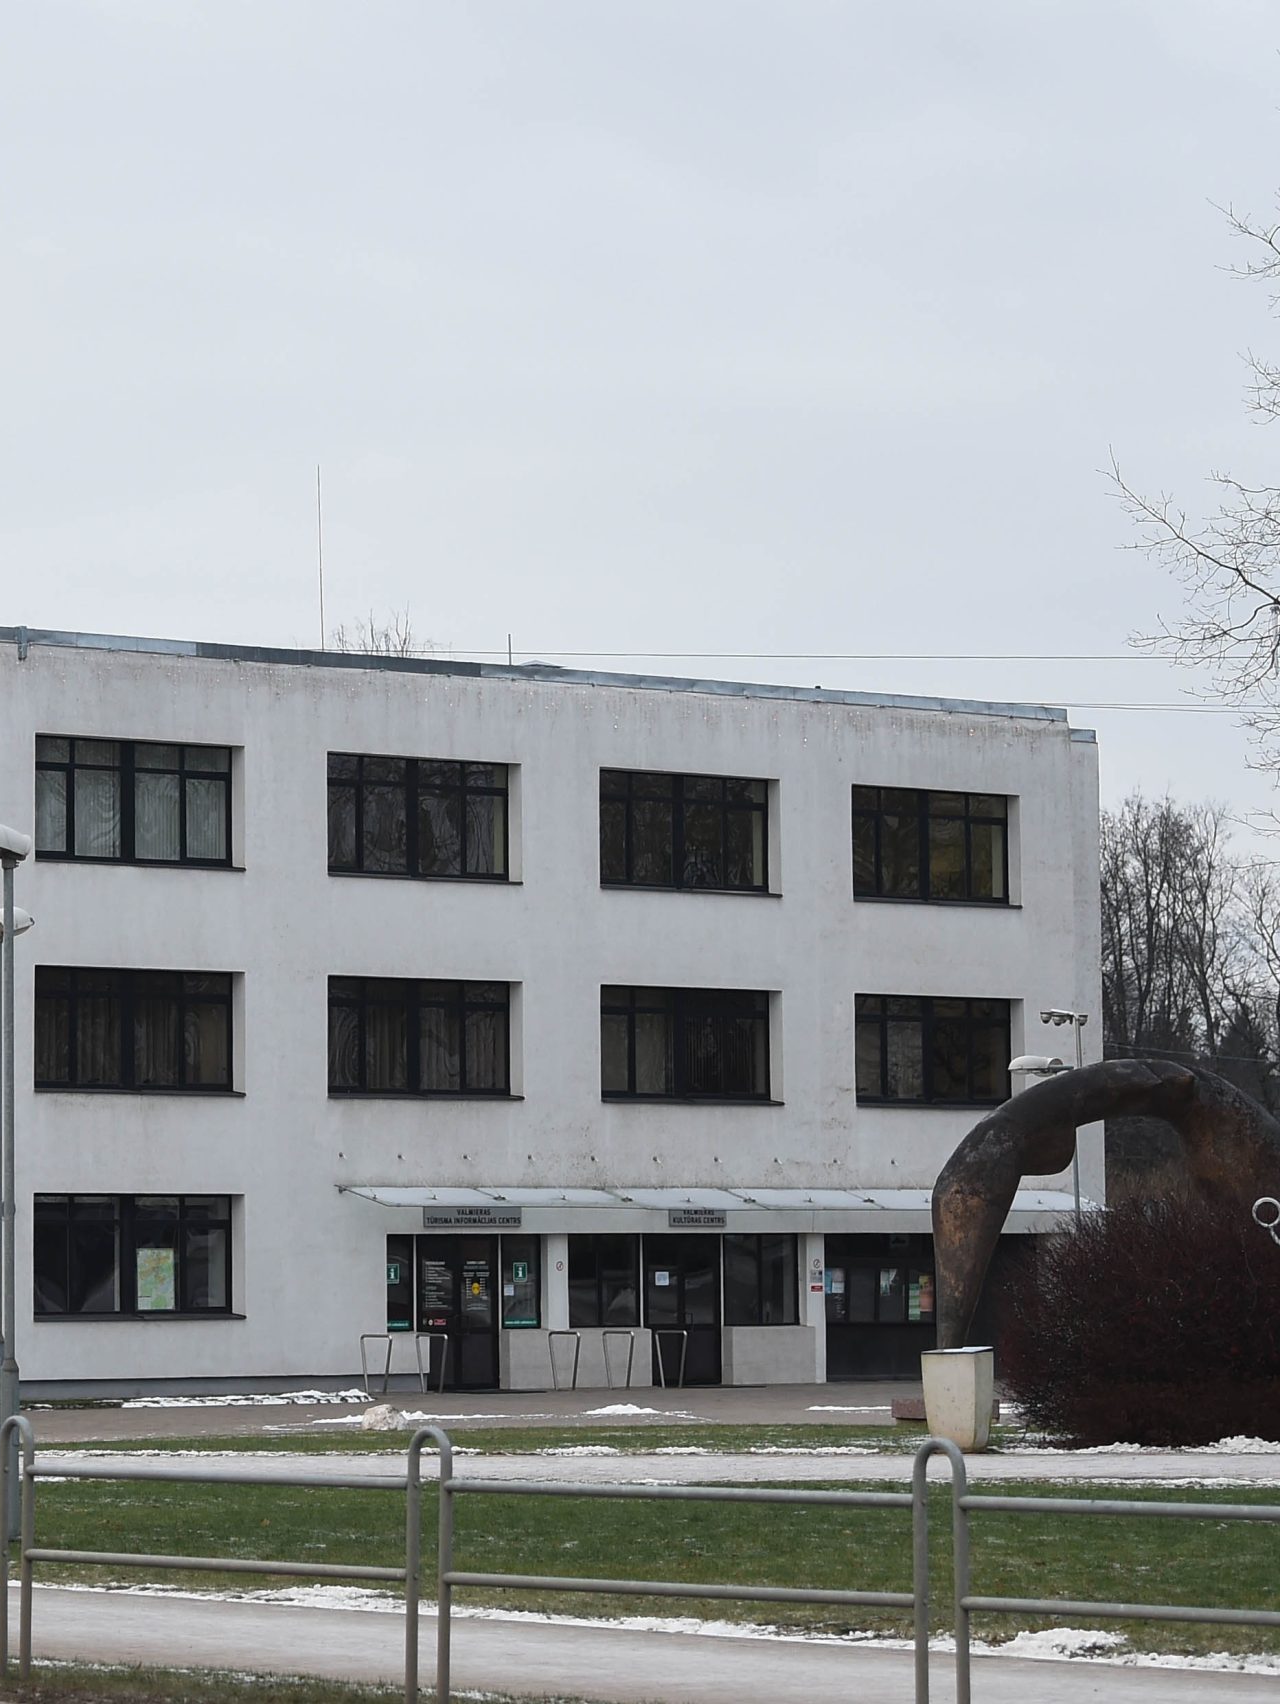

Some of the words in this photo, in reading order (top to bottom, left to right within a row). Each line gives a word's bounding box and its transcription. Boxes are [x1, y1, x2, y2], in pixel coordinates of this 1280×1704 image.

[456, 1208, 491, 1216] VALMIERAS
[426, 1216, 453, 1225] TŪRISMA
[498, 1216, 521, 1225] CENTRS
[703, 1216, 725, 1225] CENTRS
